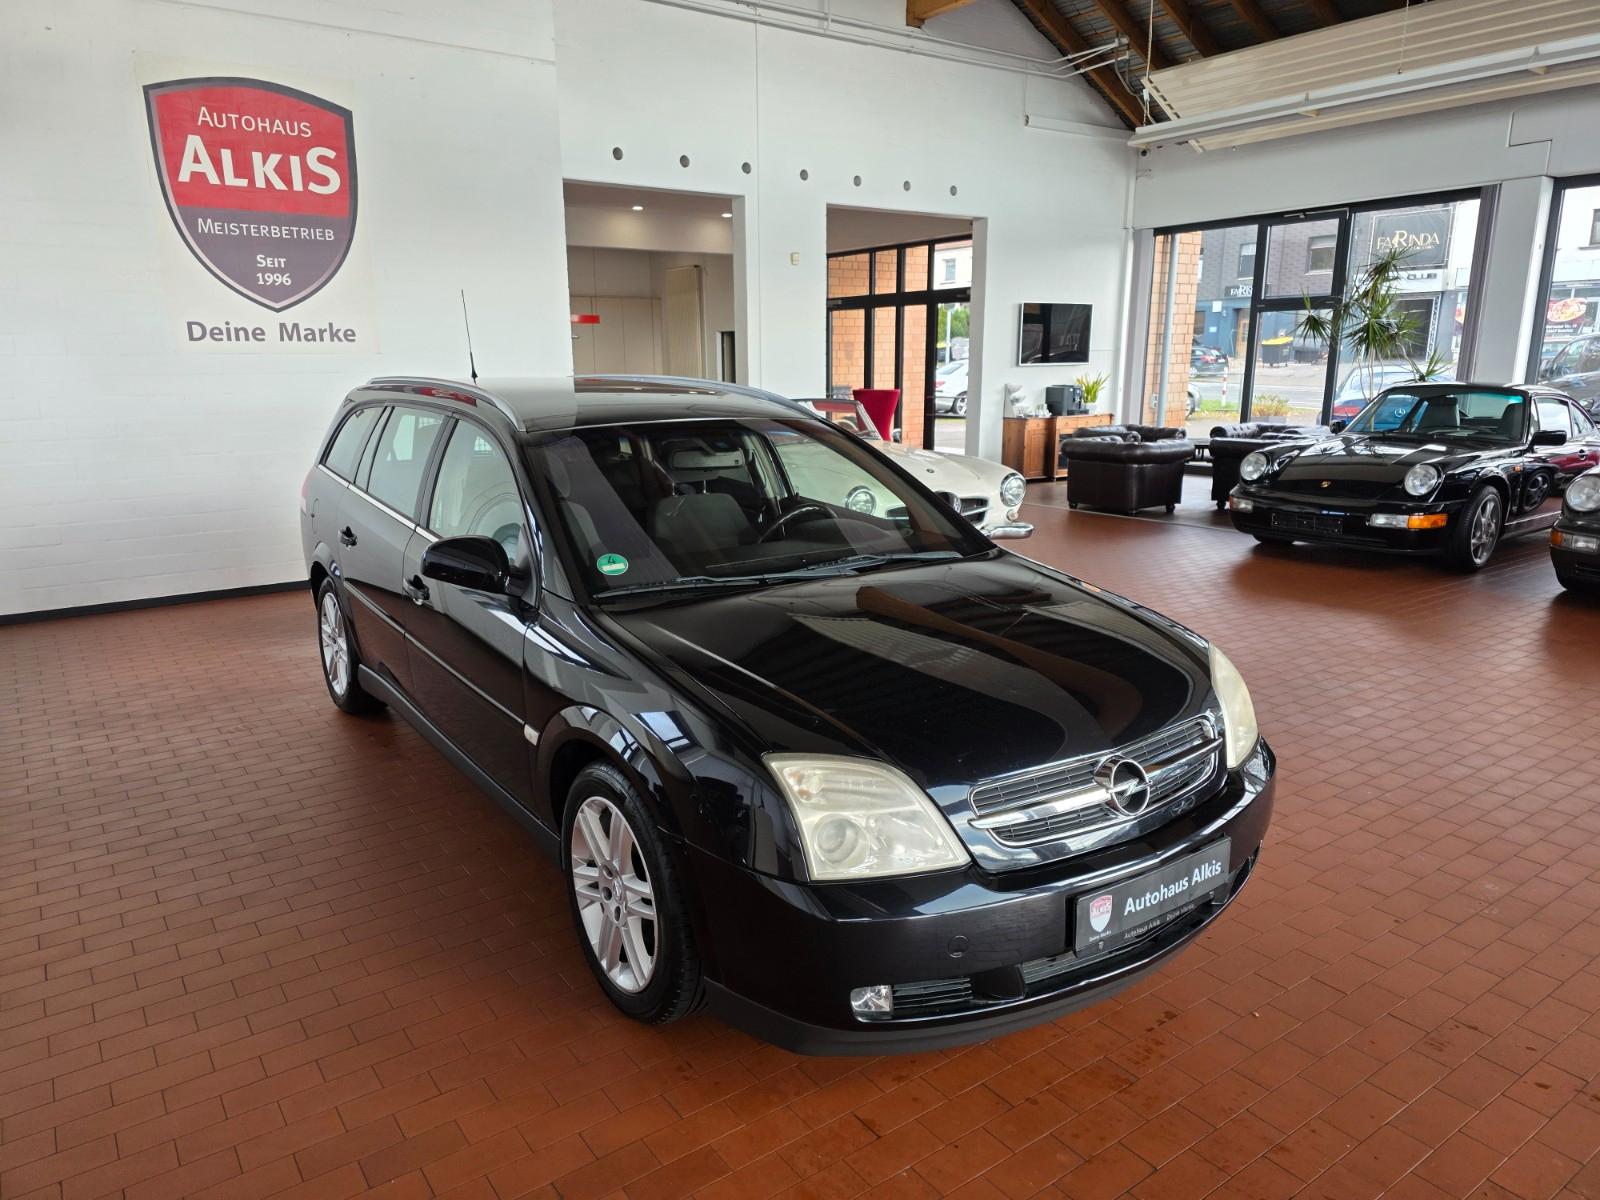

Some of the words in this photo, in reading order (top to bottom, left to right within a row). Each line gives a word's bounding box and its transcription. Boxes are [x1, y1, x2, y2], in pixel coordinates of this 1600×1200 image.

[197, 106, 312, 137] AUTOHAUS
[178, 134, 341, 195] ALKIS
[197, 218, 335, 241] MEISTERBETRIEB
[256, 254, 287, 268] SEIT
[256, 272, 292, 286] 1996
[186, 321, 266, 343] Deine
[279, 322, 357, 343] Marke
[1123, 876, 1189, 915] Autohaus
[1191, 860, 1222, 885] Alkis
